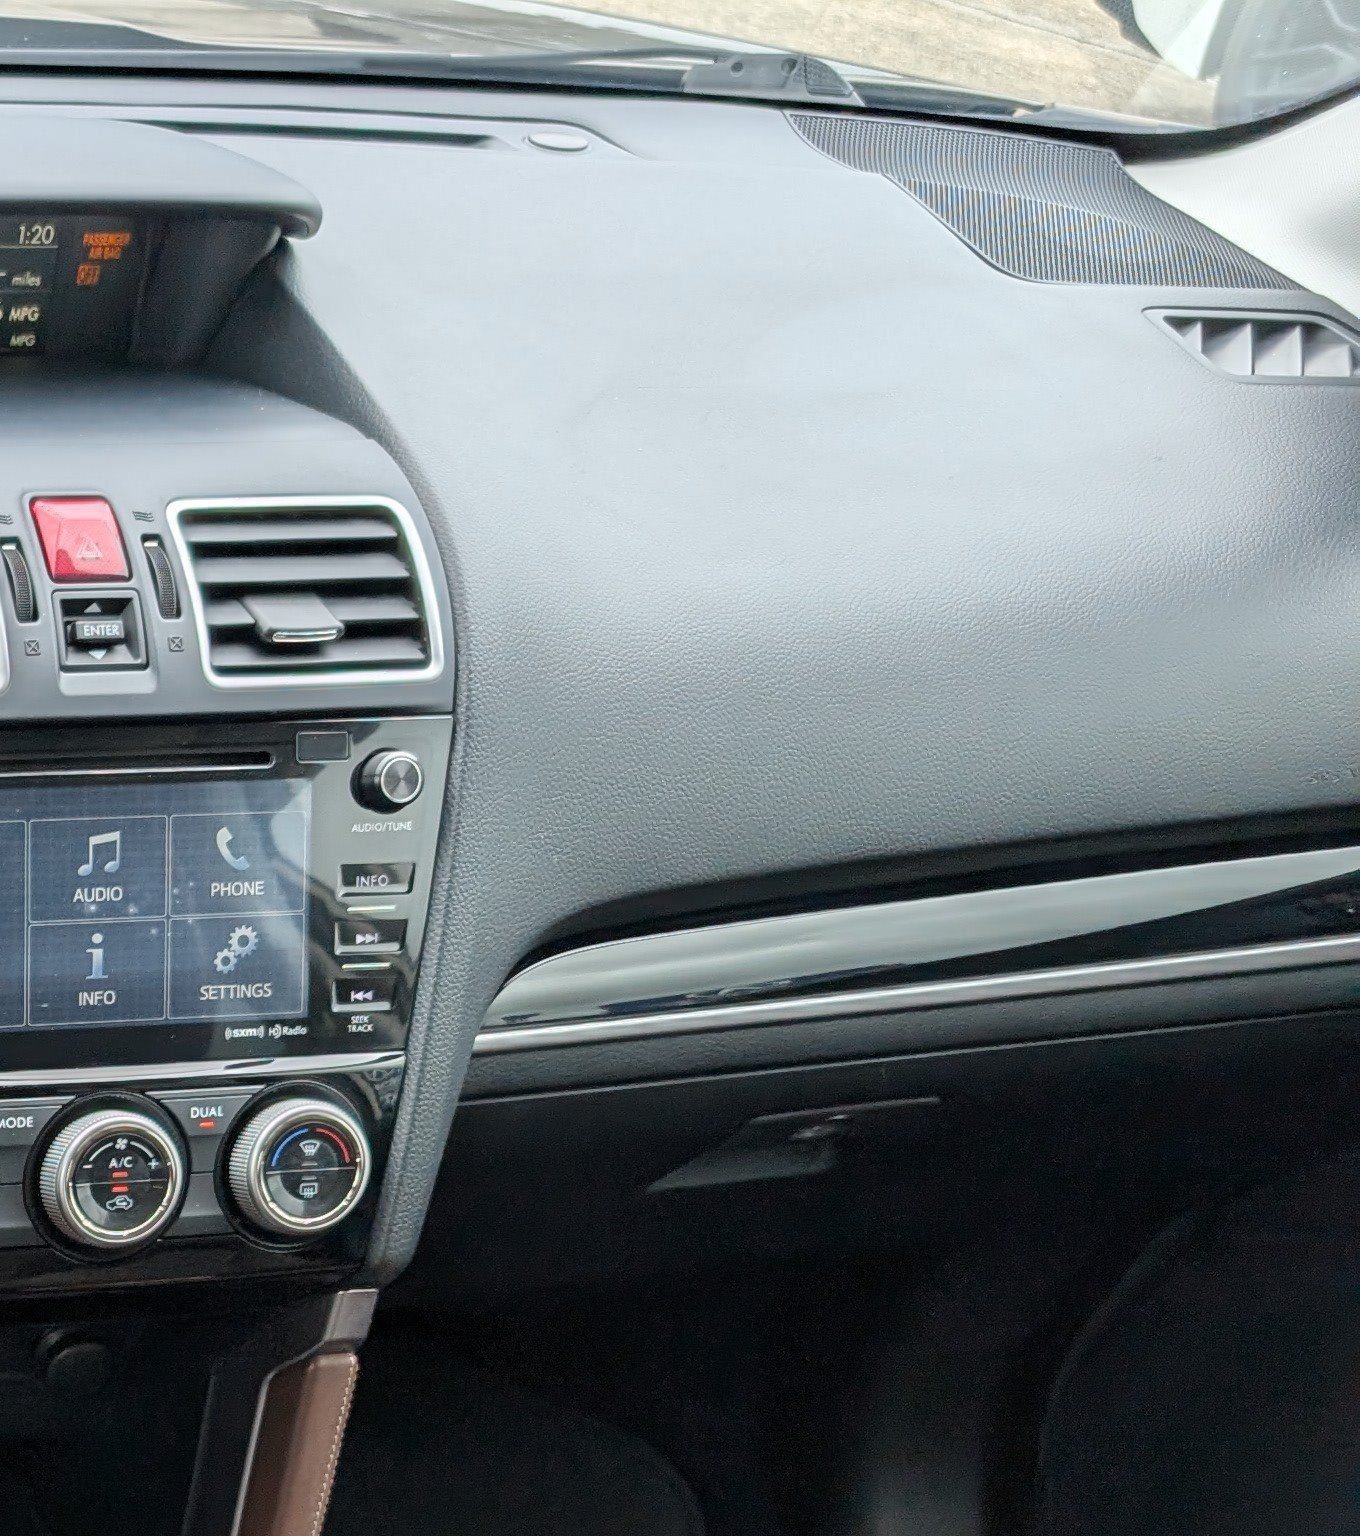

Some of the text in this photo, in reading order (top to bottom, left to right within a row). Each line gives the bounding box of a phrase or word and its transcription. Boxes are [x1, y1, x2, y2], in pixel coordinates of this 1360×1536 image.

[18, 224, 56, 245] 1:20
[12, 271, 42, 287] miles
[9, 306, 40, 322] MPG
[10, 333, 36, 348] MPG
[83, 623, 121, 638] ENTER
[351, 821, 413, 833] AUDIO/TUNE
[355, 873, 389, 888] INFO
[73, 886, 123, 903] AUDIO
[210, 881, 264, 897] PHONE
[78, 991, 116, 1007] INFO
[199, 983, 272, 1001] SETTINGS
[351, 1015, 370, 1024] SEEK
[283, 1026, 307, 1036] Radio
[347, 1024, 373, 1033] TRACK
[190, 1105, 223, 1120] DUAL
[108, 1156, 133, 1170] A/C
